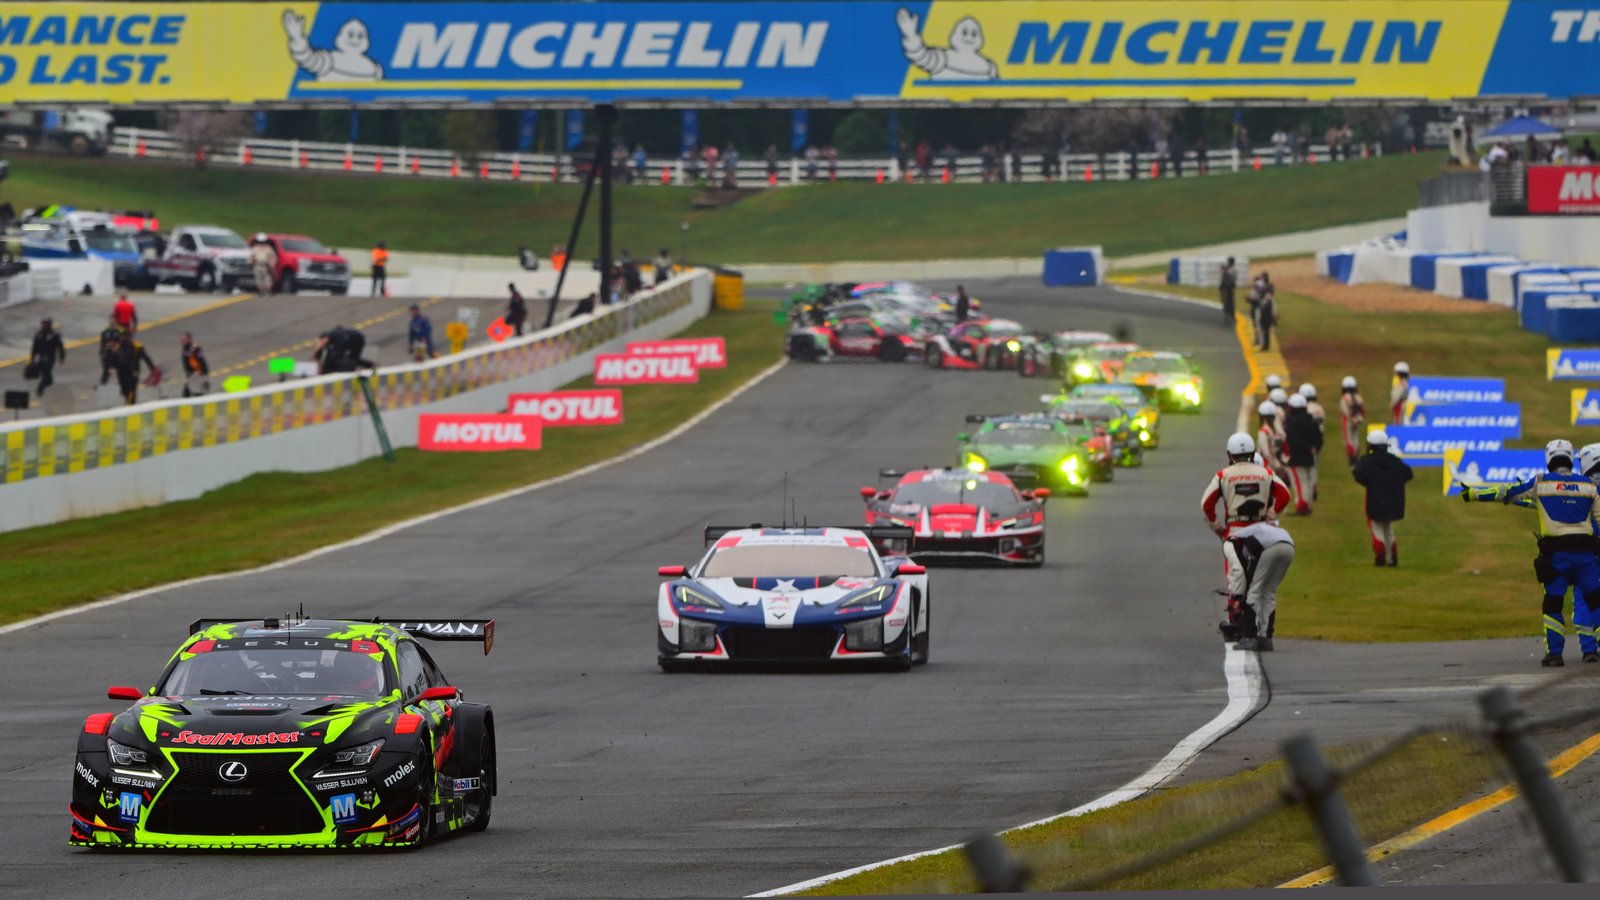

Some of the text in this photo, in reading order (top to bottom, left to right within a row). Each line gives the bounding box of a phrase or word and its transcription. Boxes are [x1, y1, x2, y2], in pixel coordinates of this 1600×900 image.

[391, 21, 829, 69] MICHELIN
[1007, 20, 1442, 64] MICHELIN
[29, 54, 171, 85] LAST.
[596, 357, 695, 381] MOTUL
[1424, 389, 1503, 403] MICHELIN
[513, 396, 618, 421] MOTUL
[433, 423, 526, 443] MOTUL
[1432, 415, 1519, 428] MICHELIN
[381, 622, 479, 635] LIVAN
[216, 639, 349, 650] LEXUS
[171, 730, 300, 746] SealMaster
[76, 762, 99, 787] molex
[384, 760, 415, 787] molex
